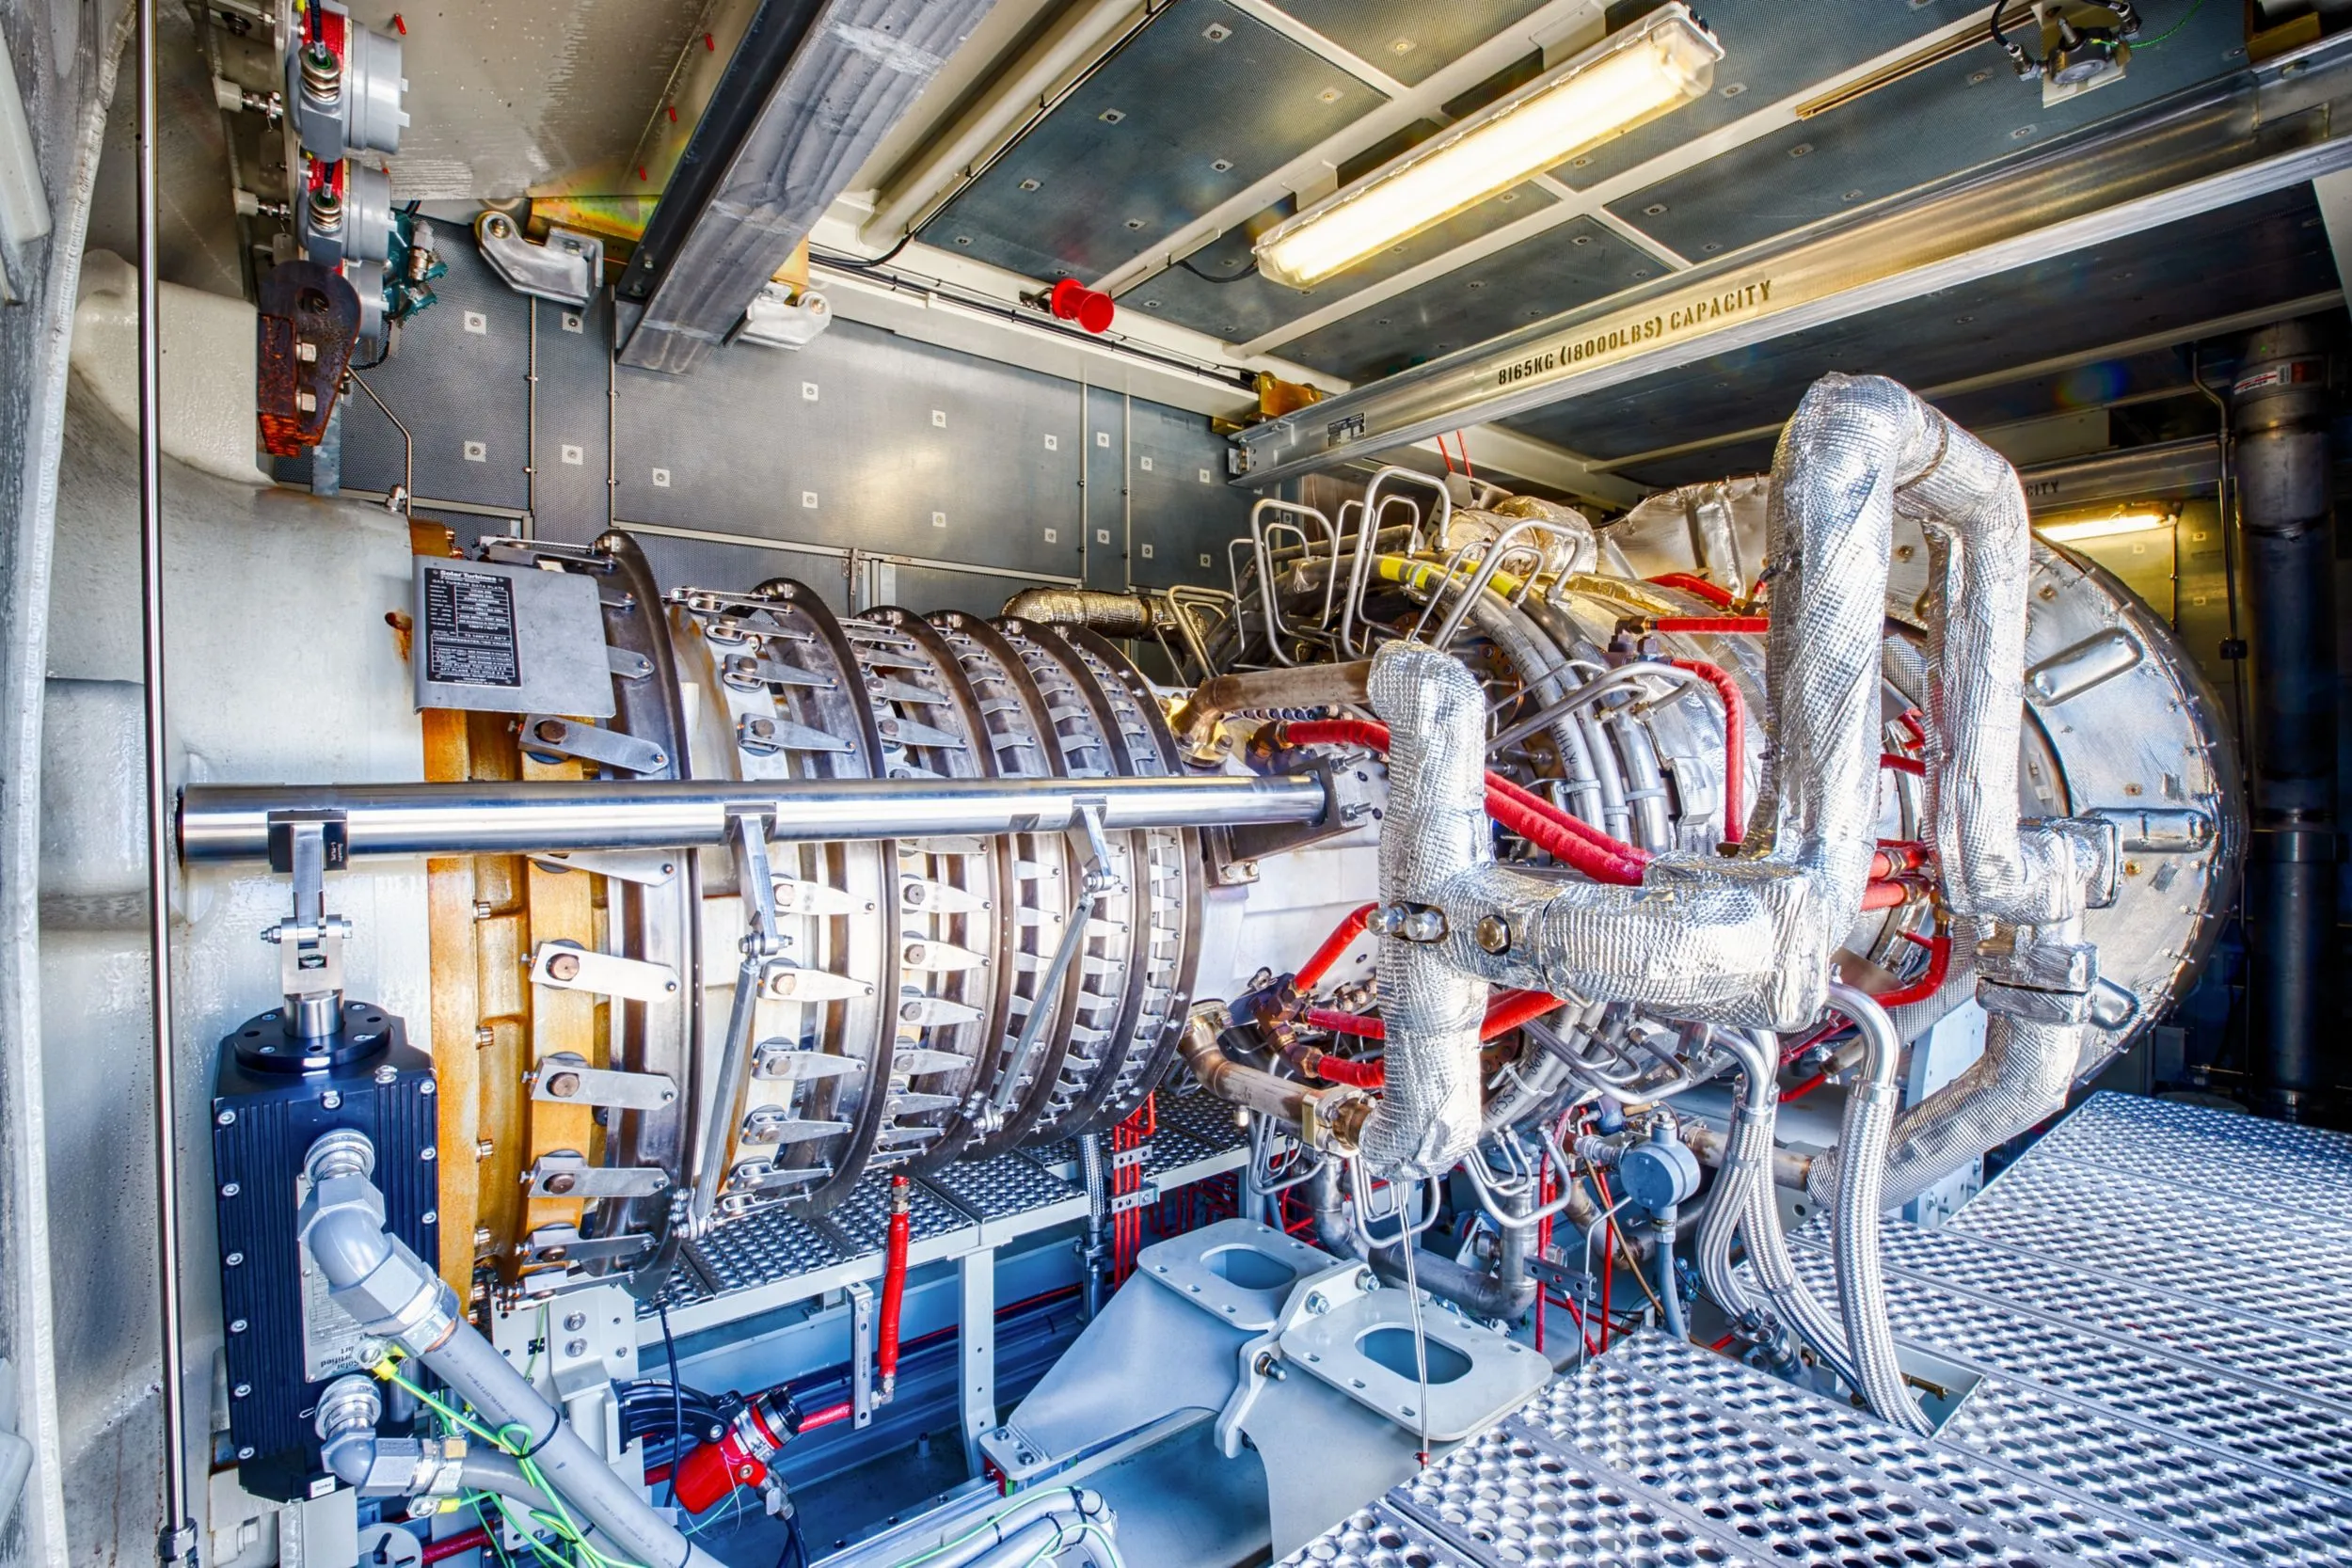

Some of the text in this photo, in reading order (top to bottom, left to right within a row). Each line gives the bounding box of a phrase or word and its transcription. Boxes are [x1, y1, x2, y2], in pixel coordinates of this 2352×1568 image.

[1498, 279, 1772, 385] 8165KG (18000LBS) CAPACITY
[2026, 479, 2058, 497] CITY
[464, 572, 496, 581] Turbines
[341, 1346, 354, 1354] art
[337, 1361, 358, 1370] Solar
